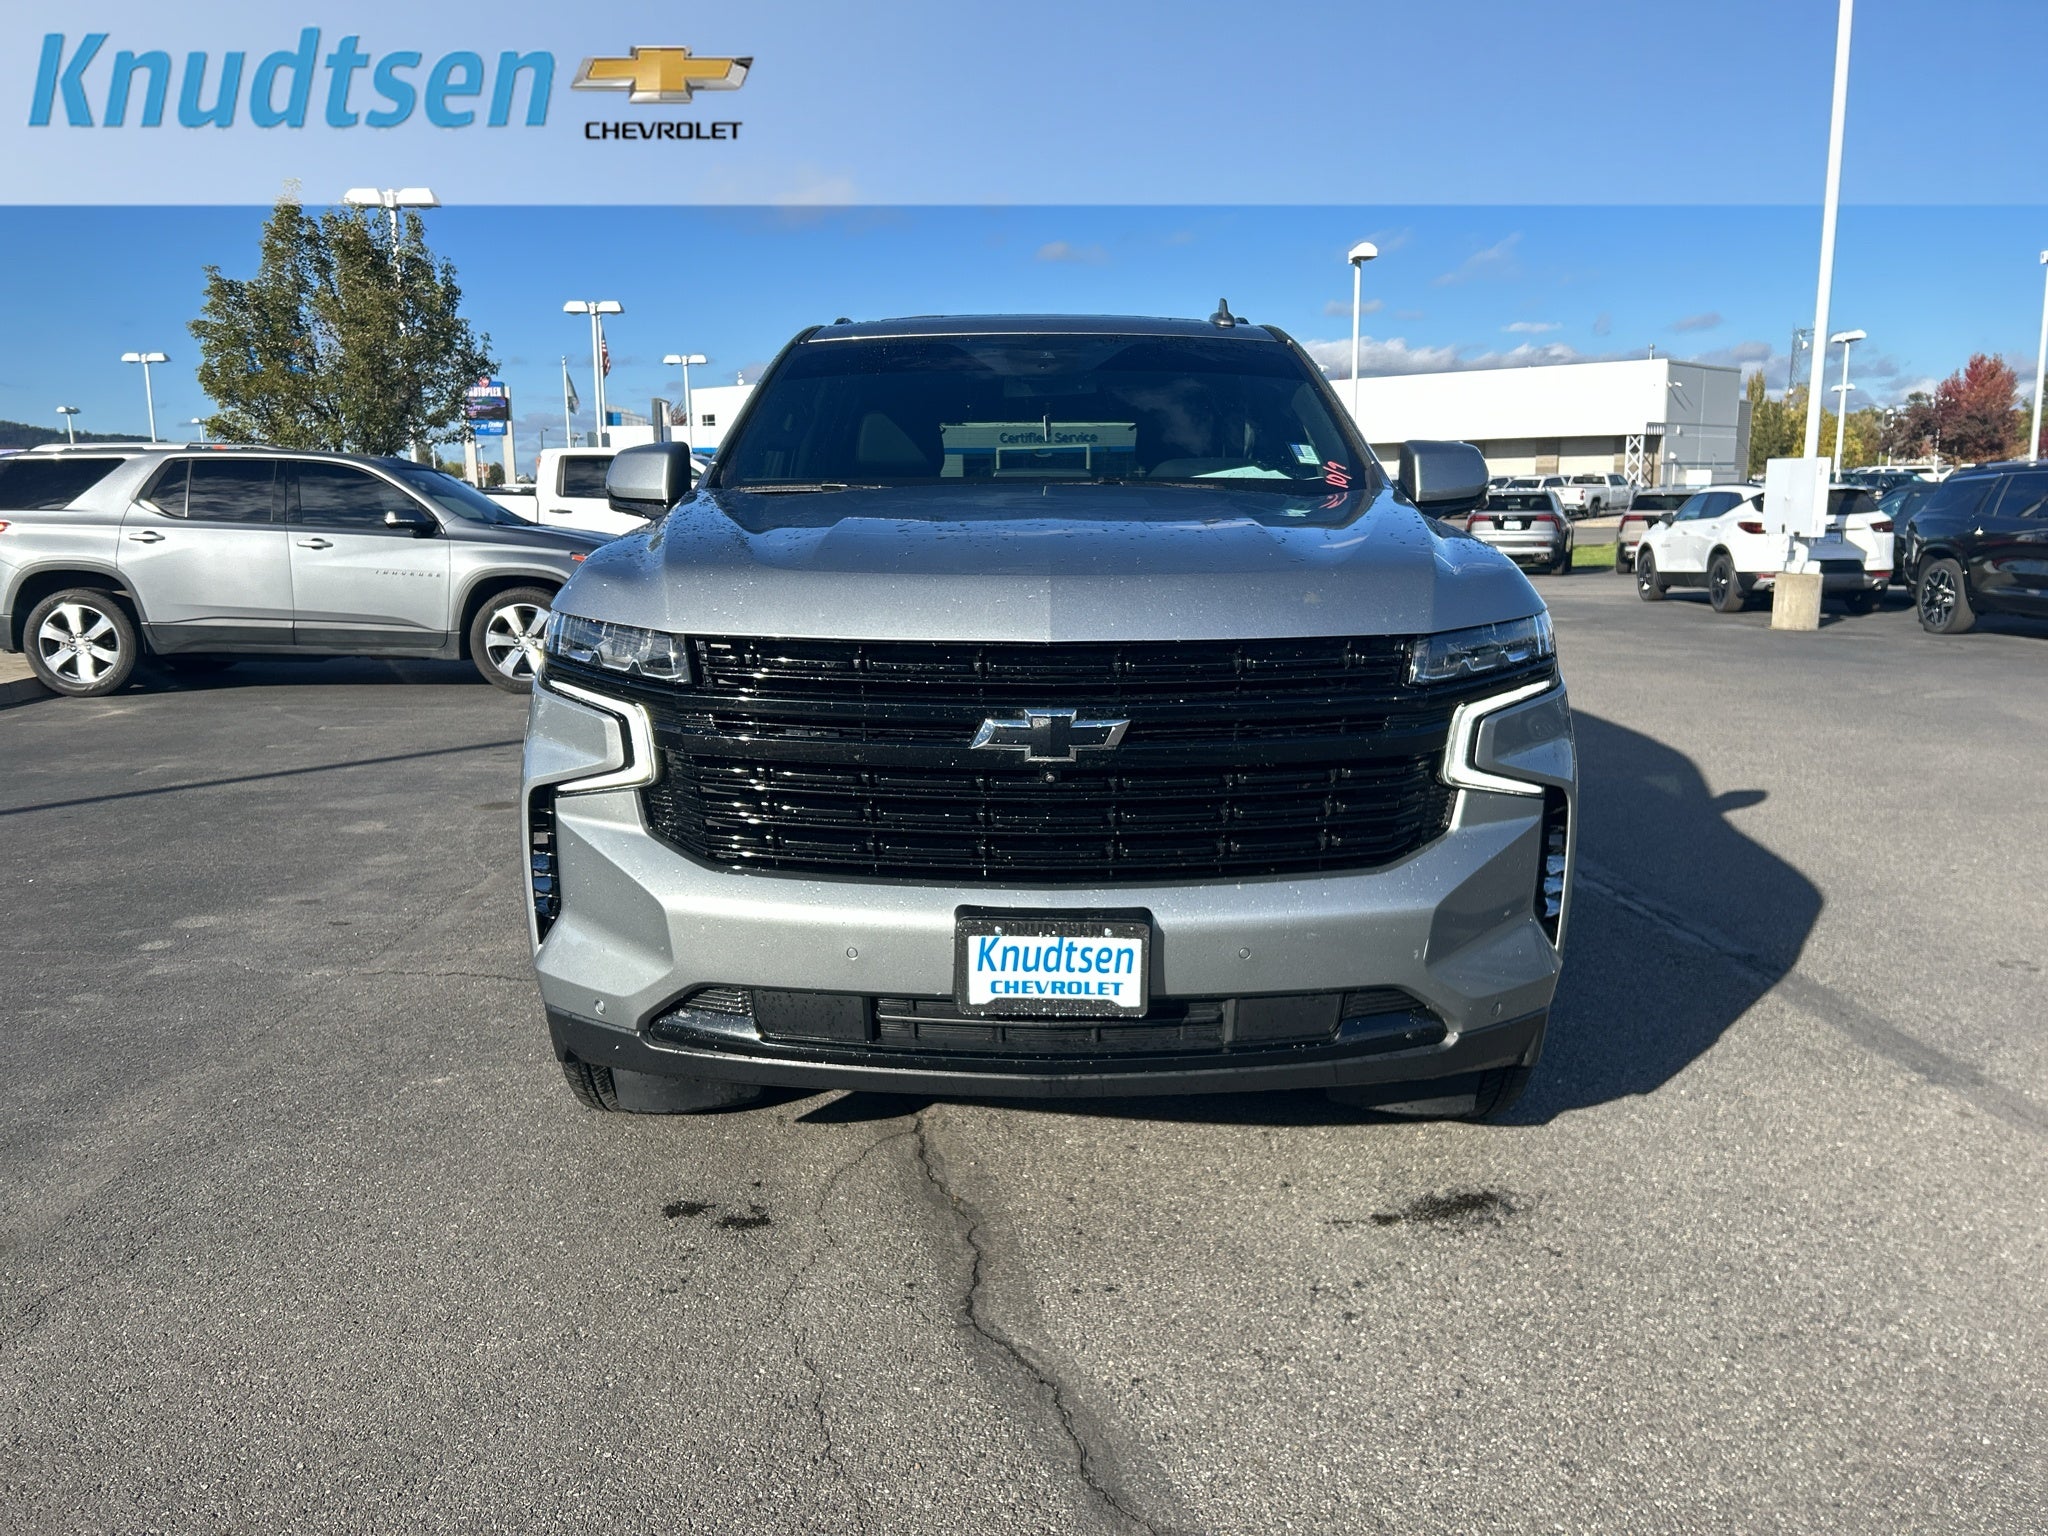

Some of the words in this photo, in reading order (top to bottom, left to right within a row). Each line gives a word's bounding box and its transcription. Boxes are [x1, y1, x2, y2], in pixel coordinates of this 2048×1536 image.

[1055, 432, 1098, 443] Service
[977, 936, 1134, 974] Knudtsen
[990, 980, 1124, 996] CHEVROLET
